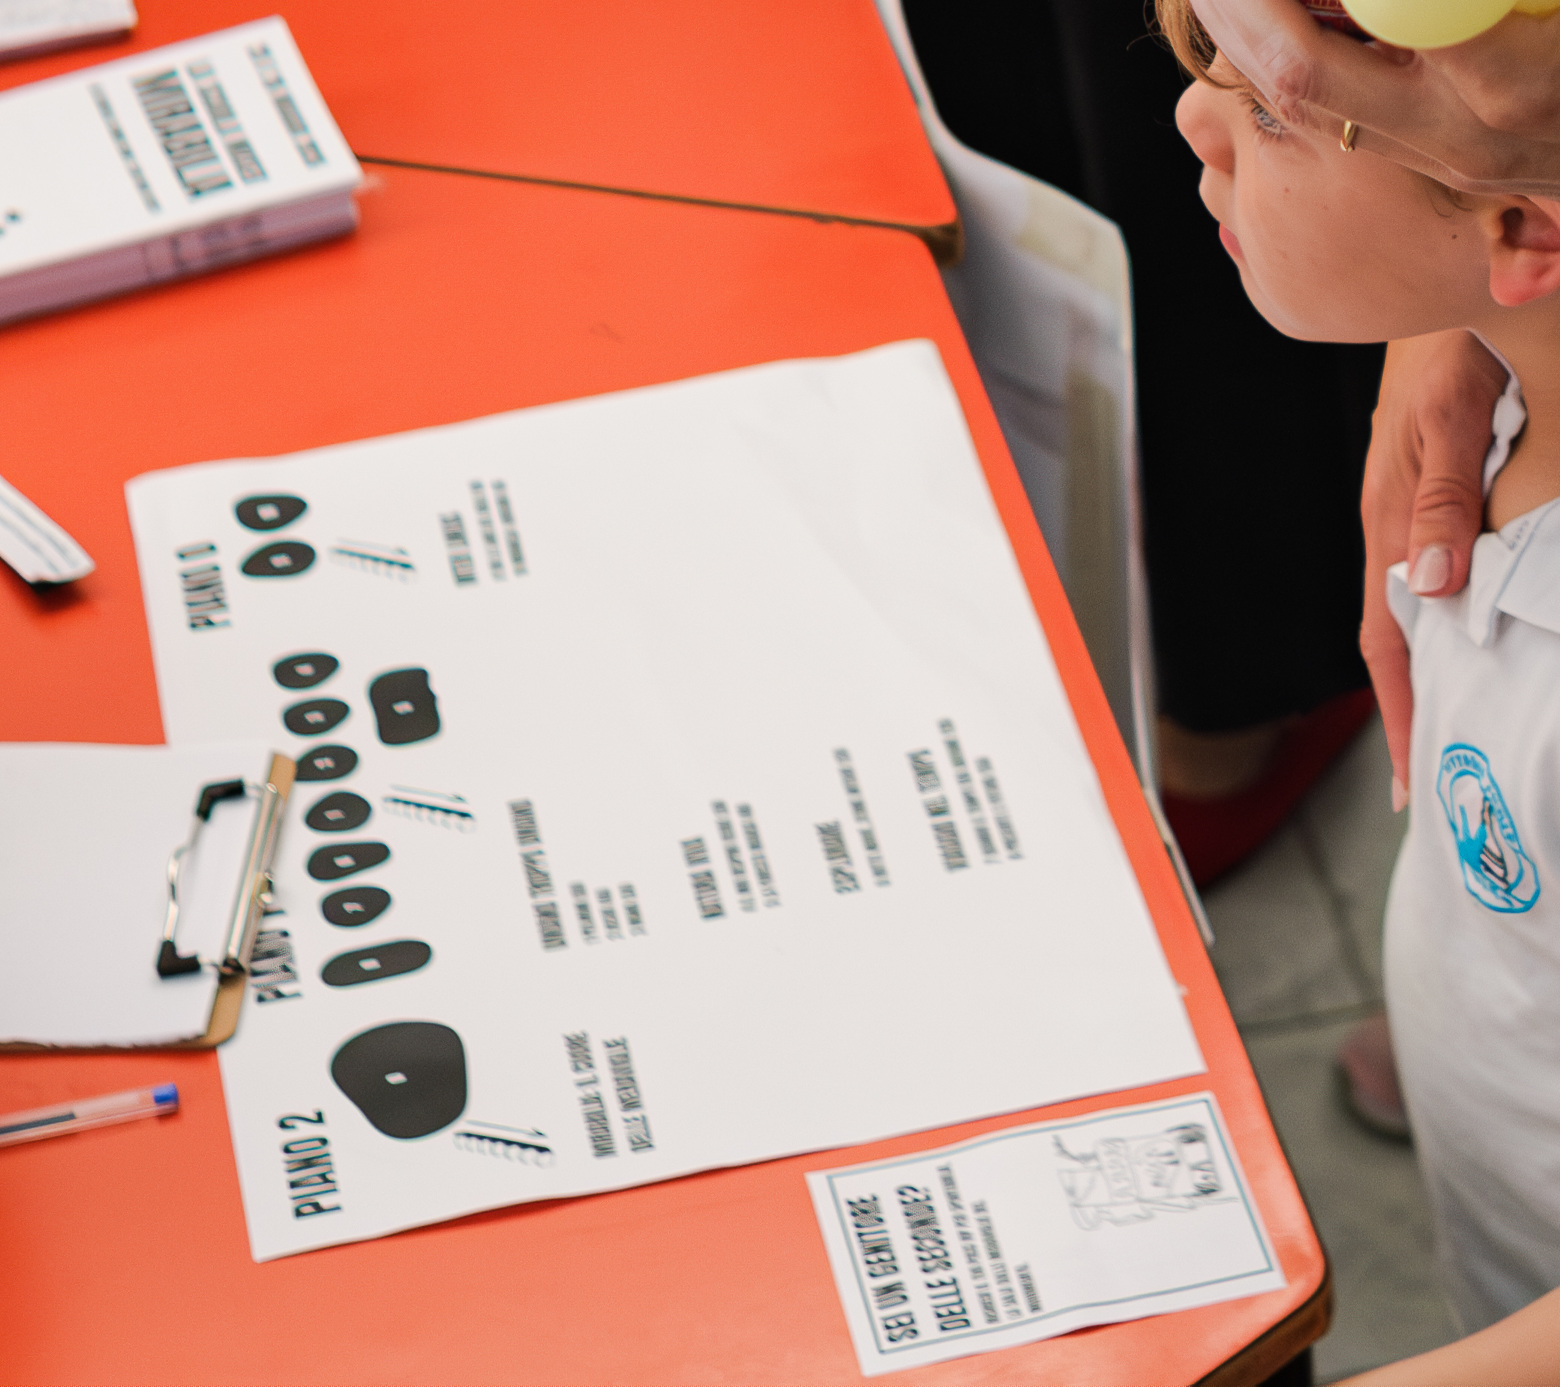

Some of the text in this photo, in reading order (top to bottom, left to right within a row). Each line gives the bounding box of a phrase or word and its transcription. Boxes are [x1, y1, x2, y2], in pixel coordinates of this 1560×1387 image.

[180, 562, 230, 632] PIANO
[243, 926, 301, 1004] PIANO
[276, 1107, 342, 1219] PIANO 2
[845, 1192, 919, 1343] SEI UN GENITORE
[895, 1181, 952, 1274] SECONDE?
[923, 1275, 970, 1332] DELLE
